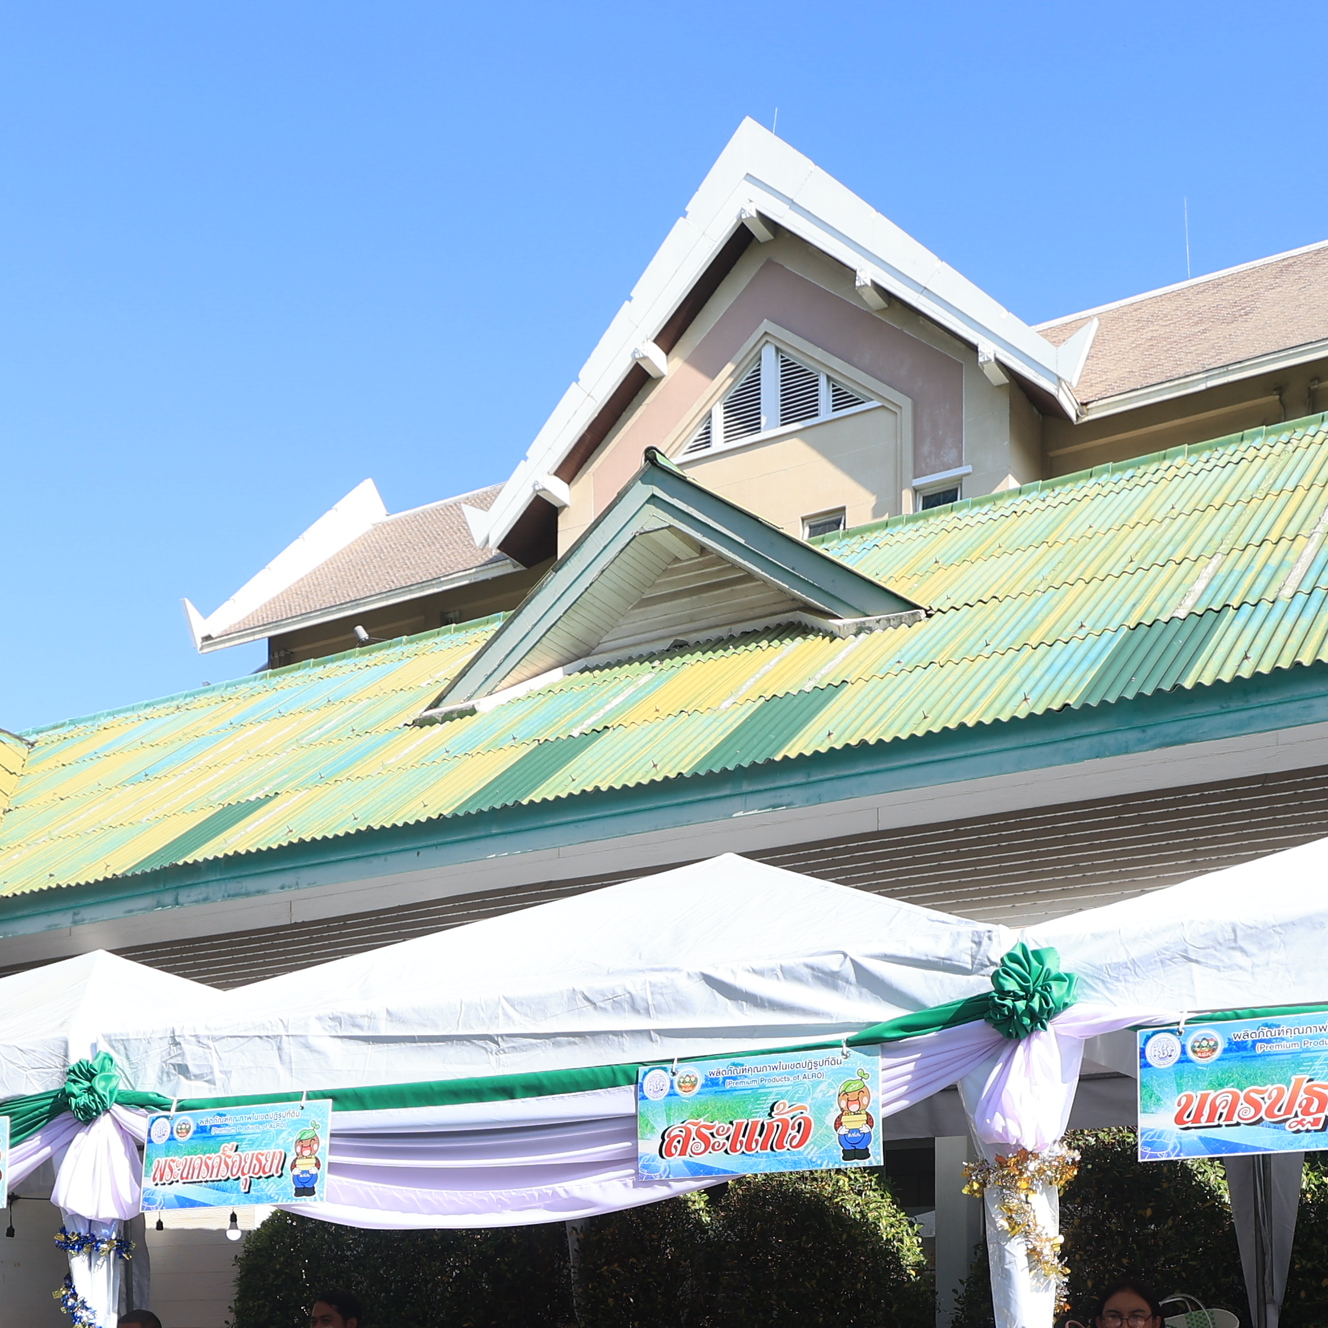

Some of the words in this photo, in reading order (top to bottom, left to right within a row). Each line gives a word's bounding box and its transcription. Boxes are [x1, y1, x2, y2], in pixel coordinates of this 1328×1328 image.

[1256, 1041, 1300, 1054] (Premium
[725, 1078, 758, 1088] (Premium
[760, 1075, 791, 1085] Products
[792, 1073, 801, 1082] of
[802, 1071, 826, 1081] ALRO)
[662, 1100, 813, 1159] สระแก้ว
[150, 1142, 285, 1193] พระนครศรีอยุธยา
